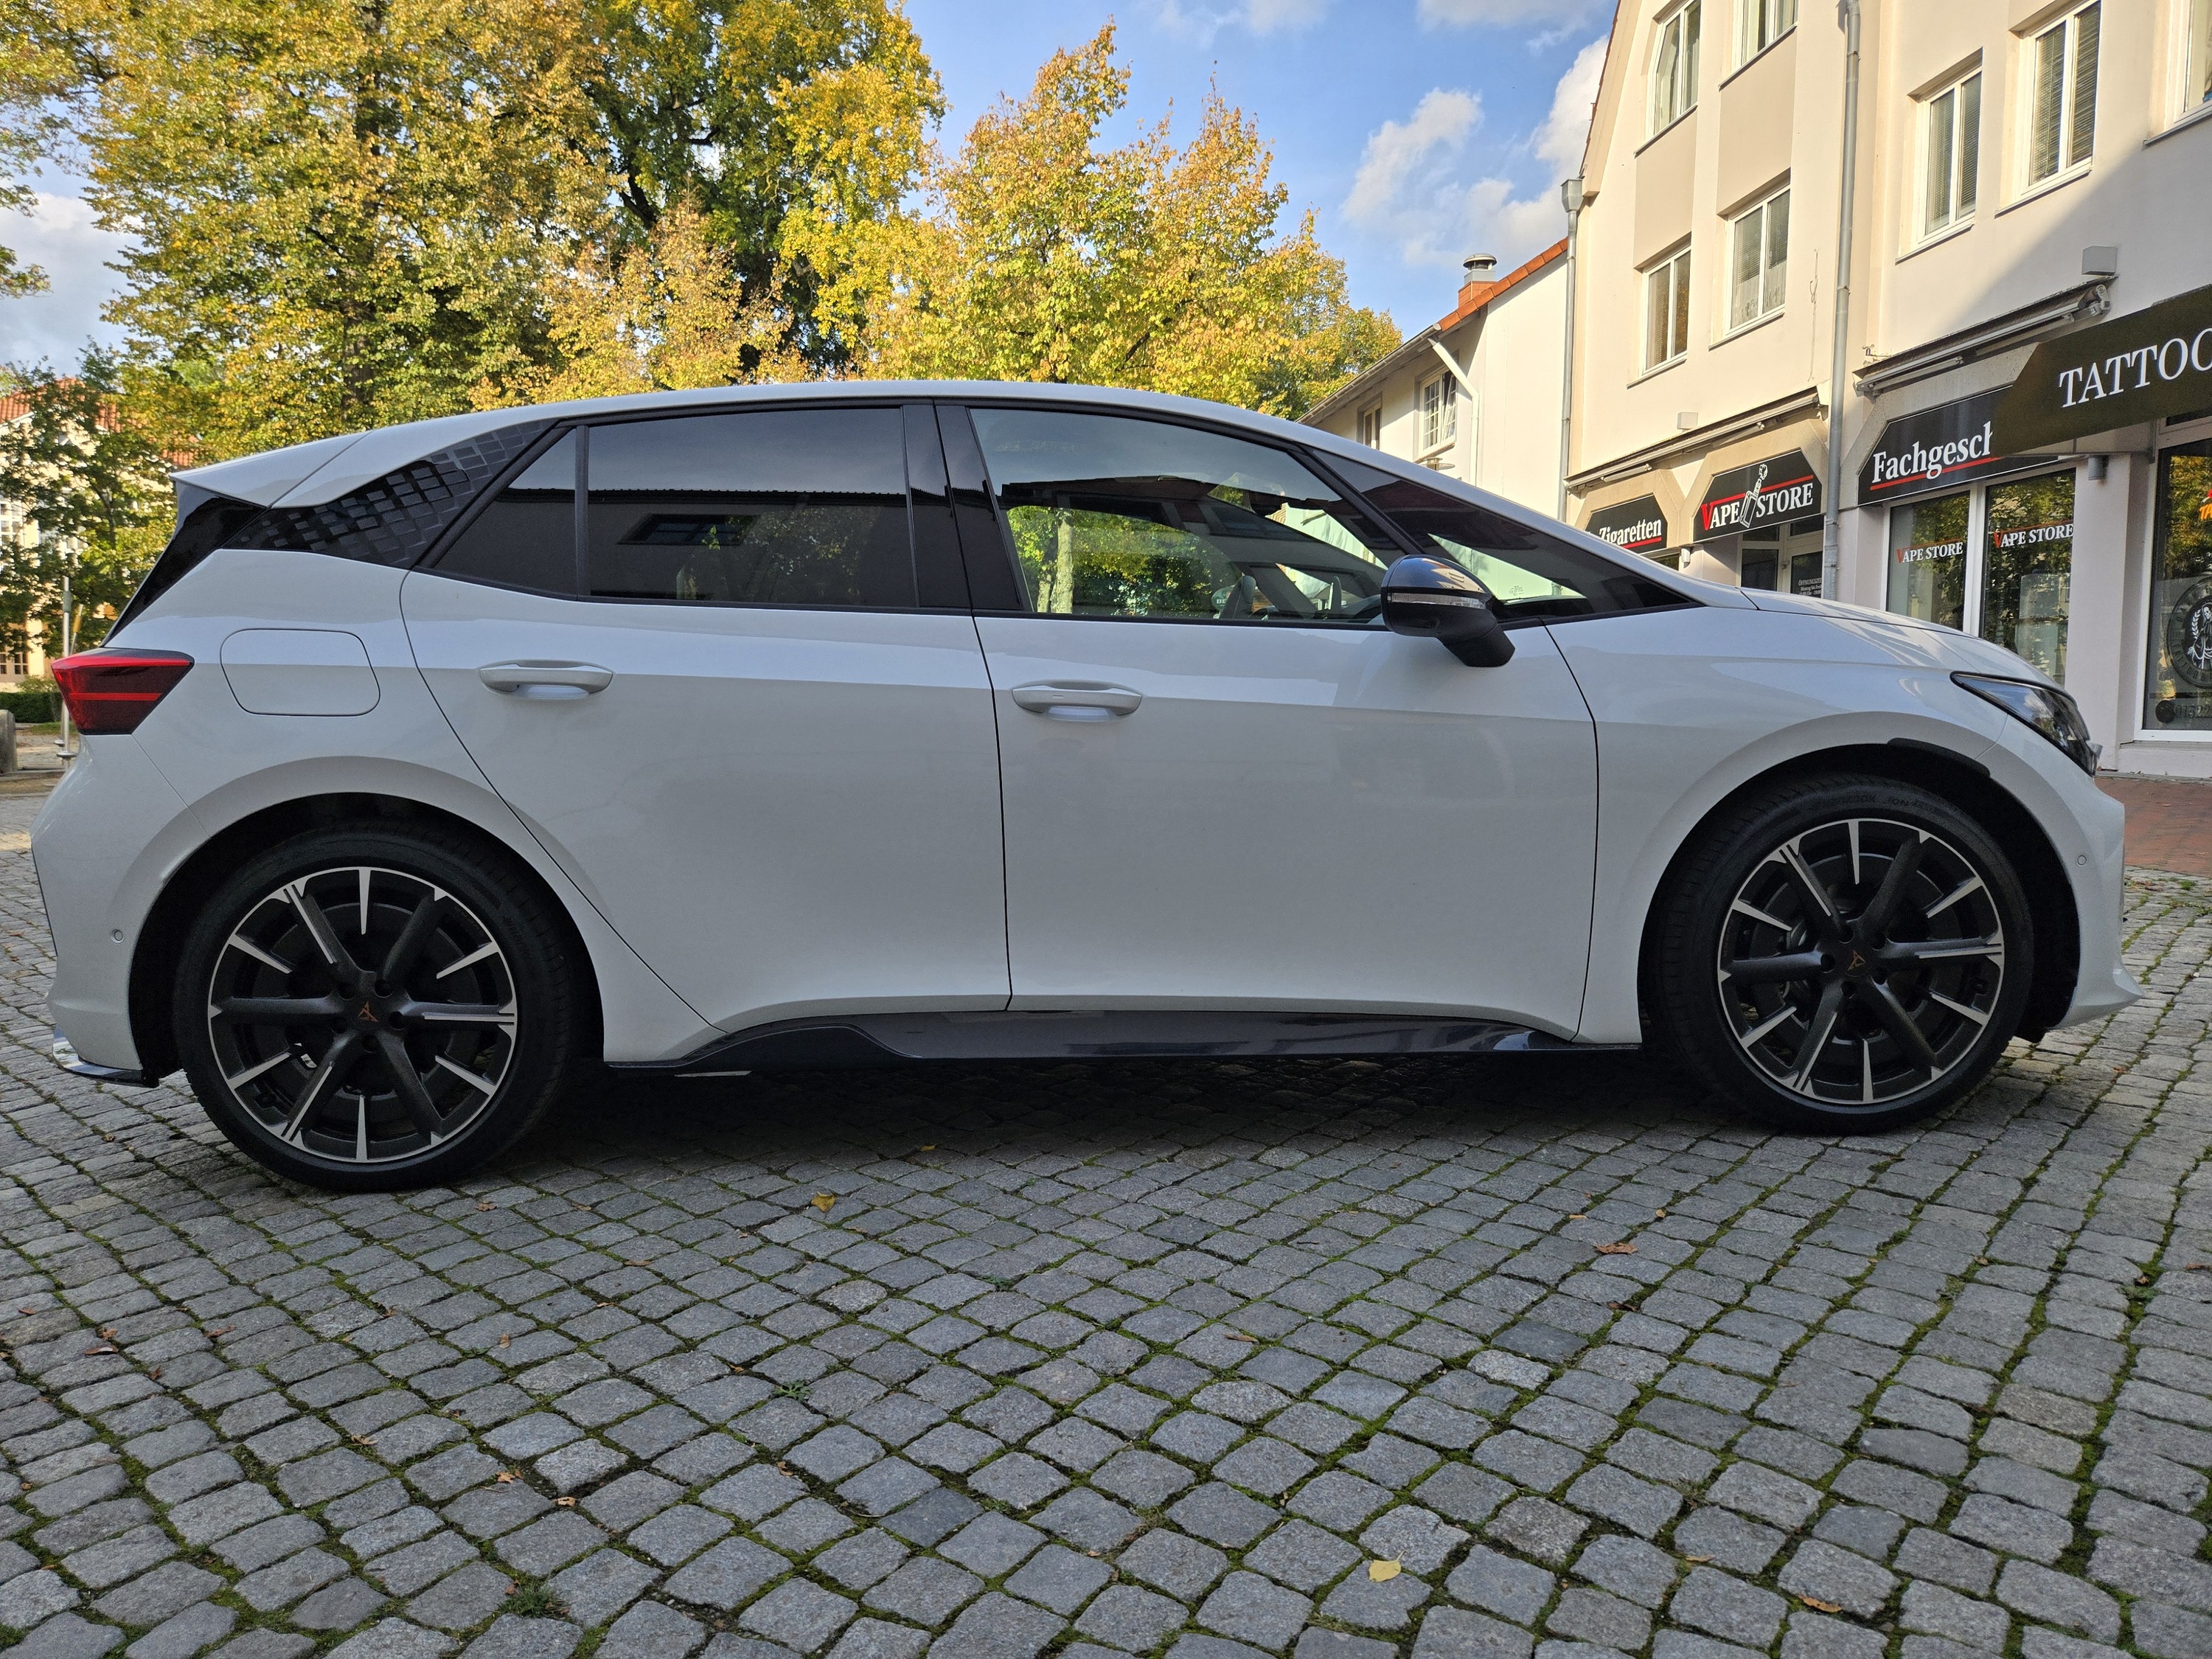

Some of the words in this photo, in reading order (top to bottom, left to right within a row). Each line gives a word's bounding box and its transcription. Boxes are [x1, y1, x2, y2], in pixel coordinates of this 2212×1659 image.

[1701, 501, 1740, 531] VAPE
[1756, 482, 1814, 518] STORE
[1994, 530, 2026, 549] VAPE
[2028, 524, 2074, 543] STORE
[1896, 547, 1924, 563] VAPE
[1925, 542, 1964, 560] STORE
